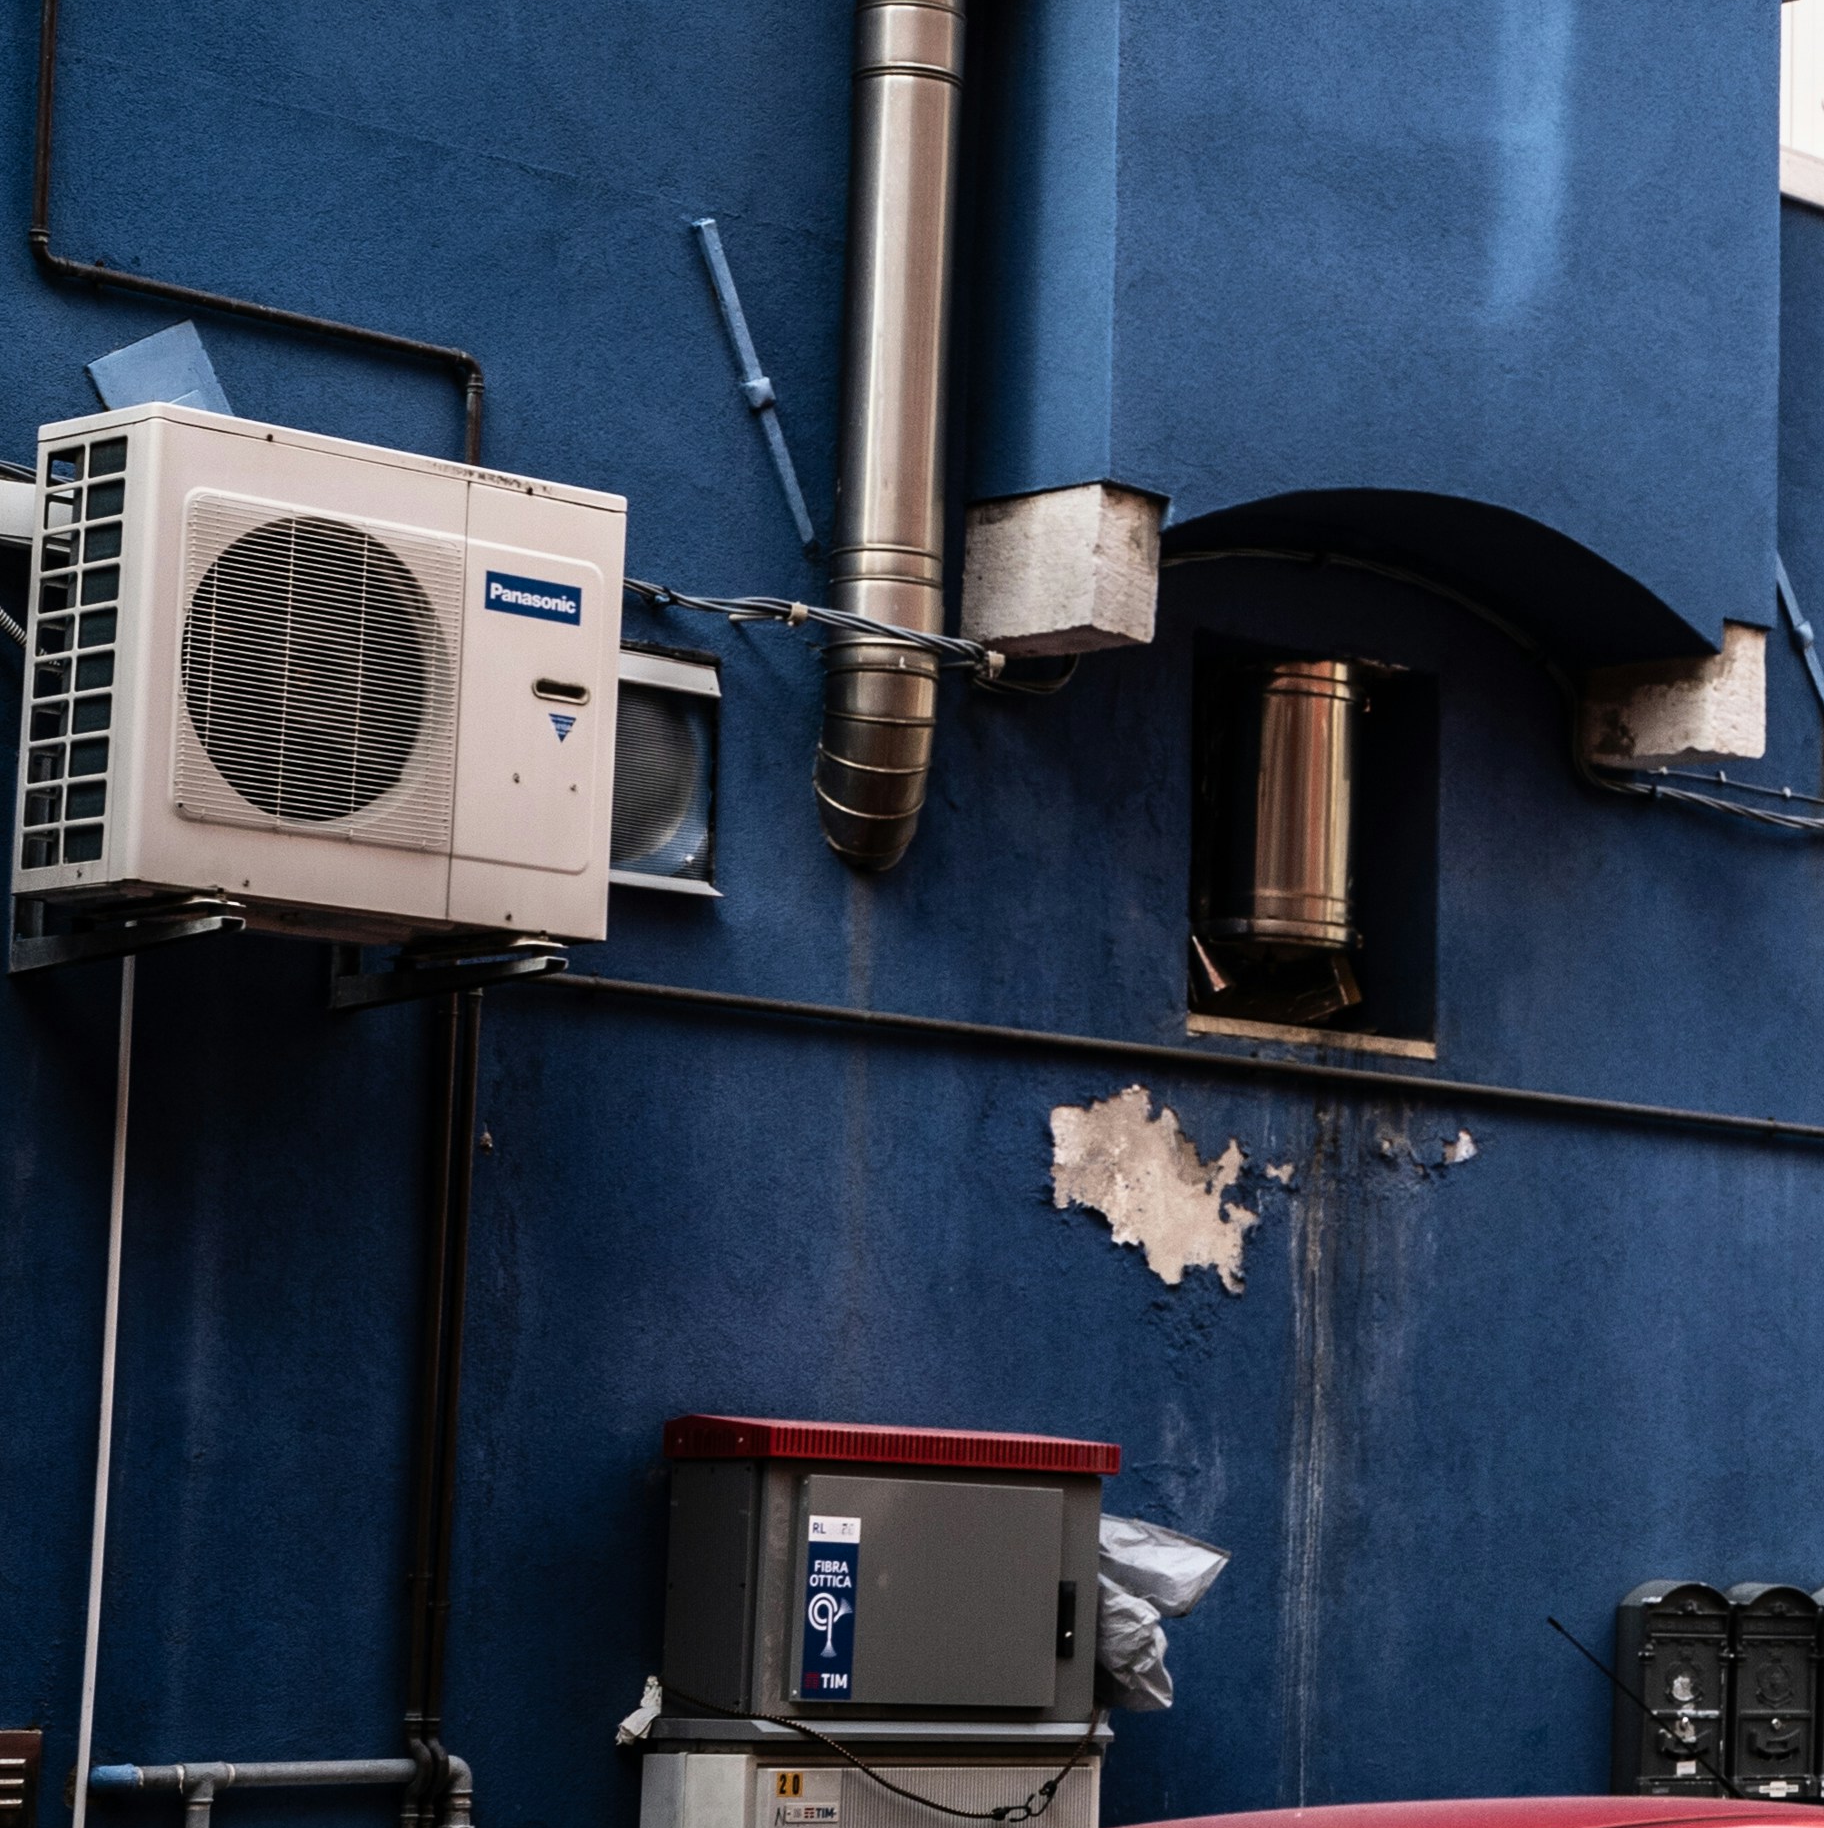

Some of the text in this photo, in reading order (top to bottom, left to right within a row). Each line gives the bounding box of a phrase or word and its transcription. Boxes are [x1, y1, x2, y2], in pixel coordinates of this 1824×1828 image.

[490, 581, 577, 614] Panasonic
[812, 1521, 827, 1534] RL
[814, 1559, 849, 1574] FIBRA
[809, 1573, 853, 1589] OTTICA
[820, 1673, 848, 1689] TIM
[815, 1807, 835, 1819] TIM
